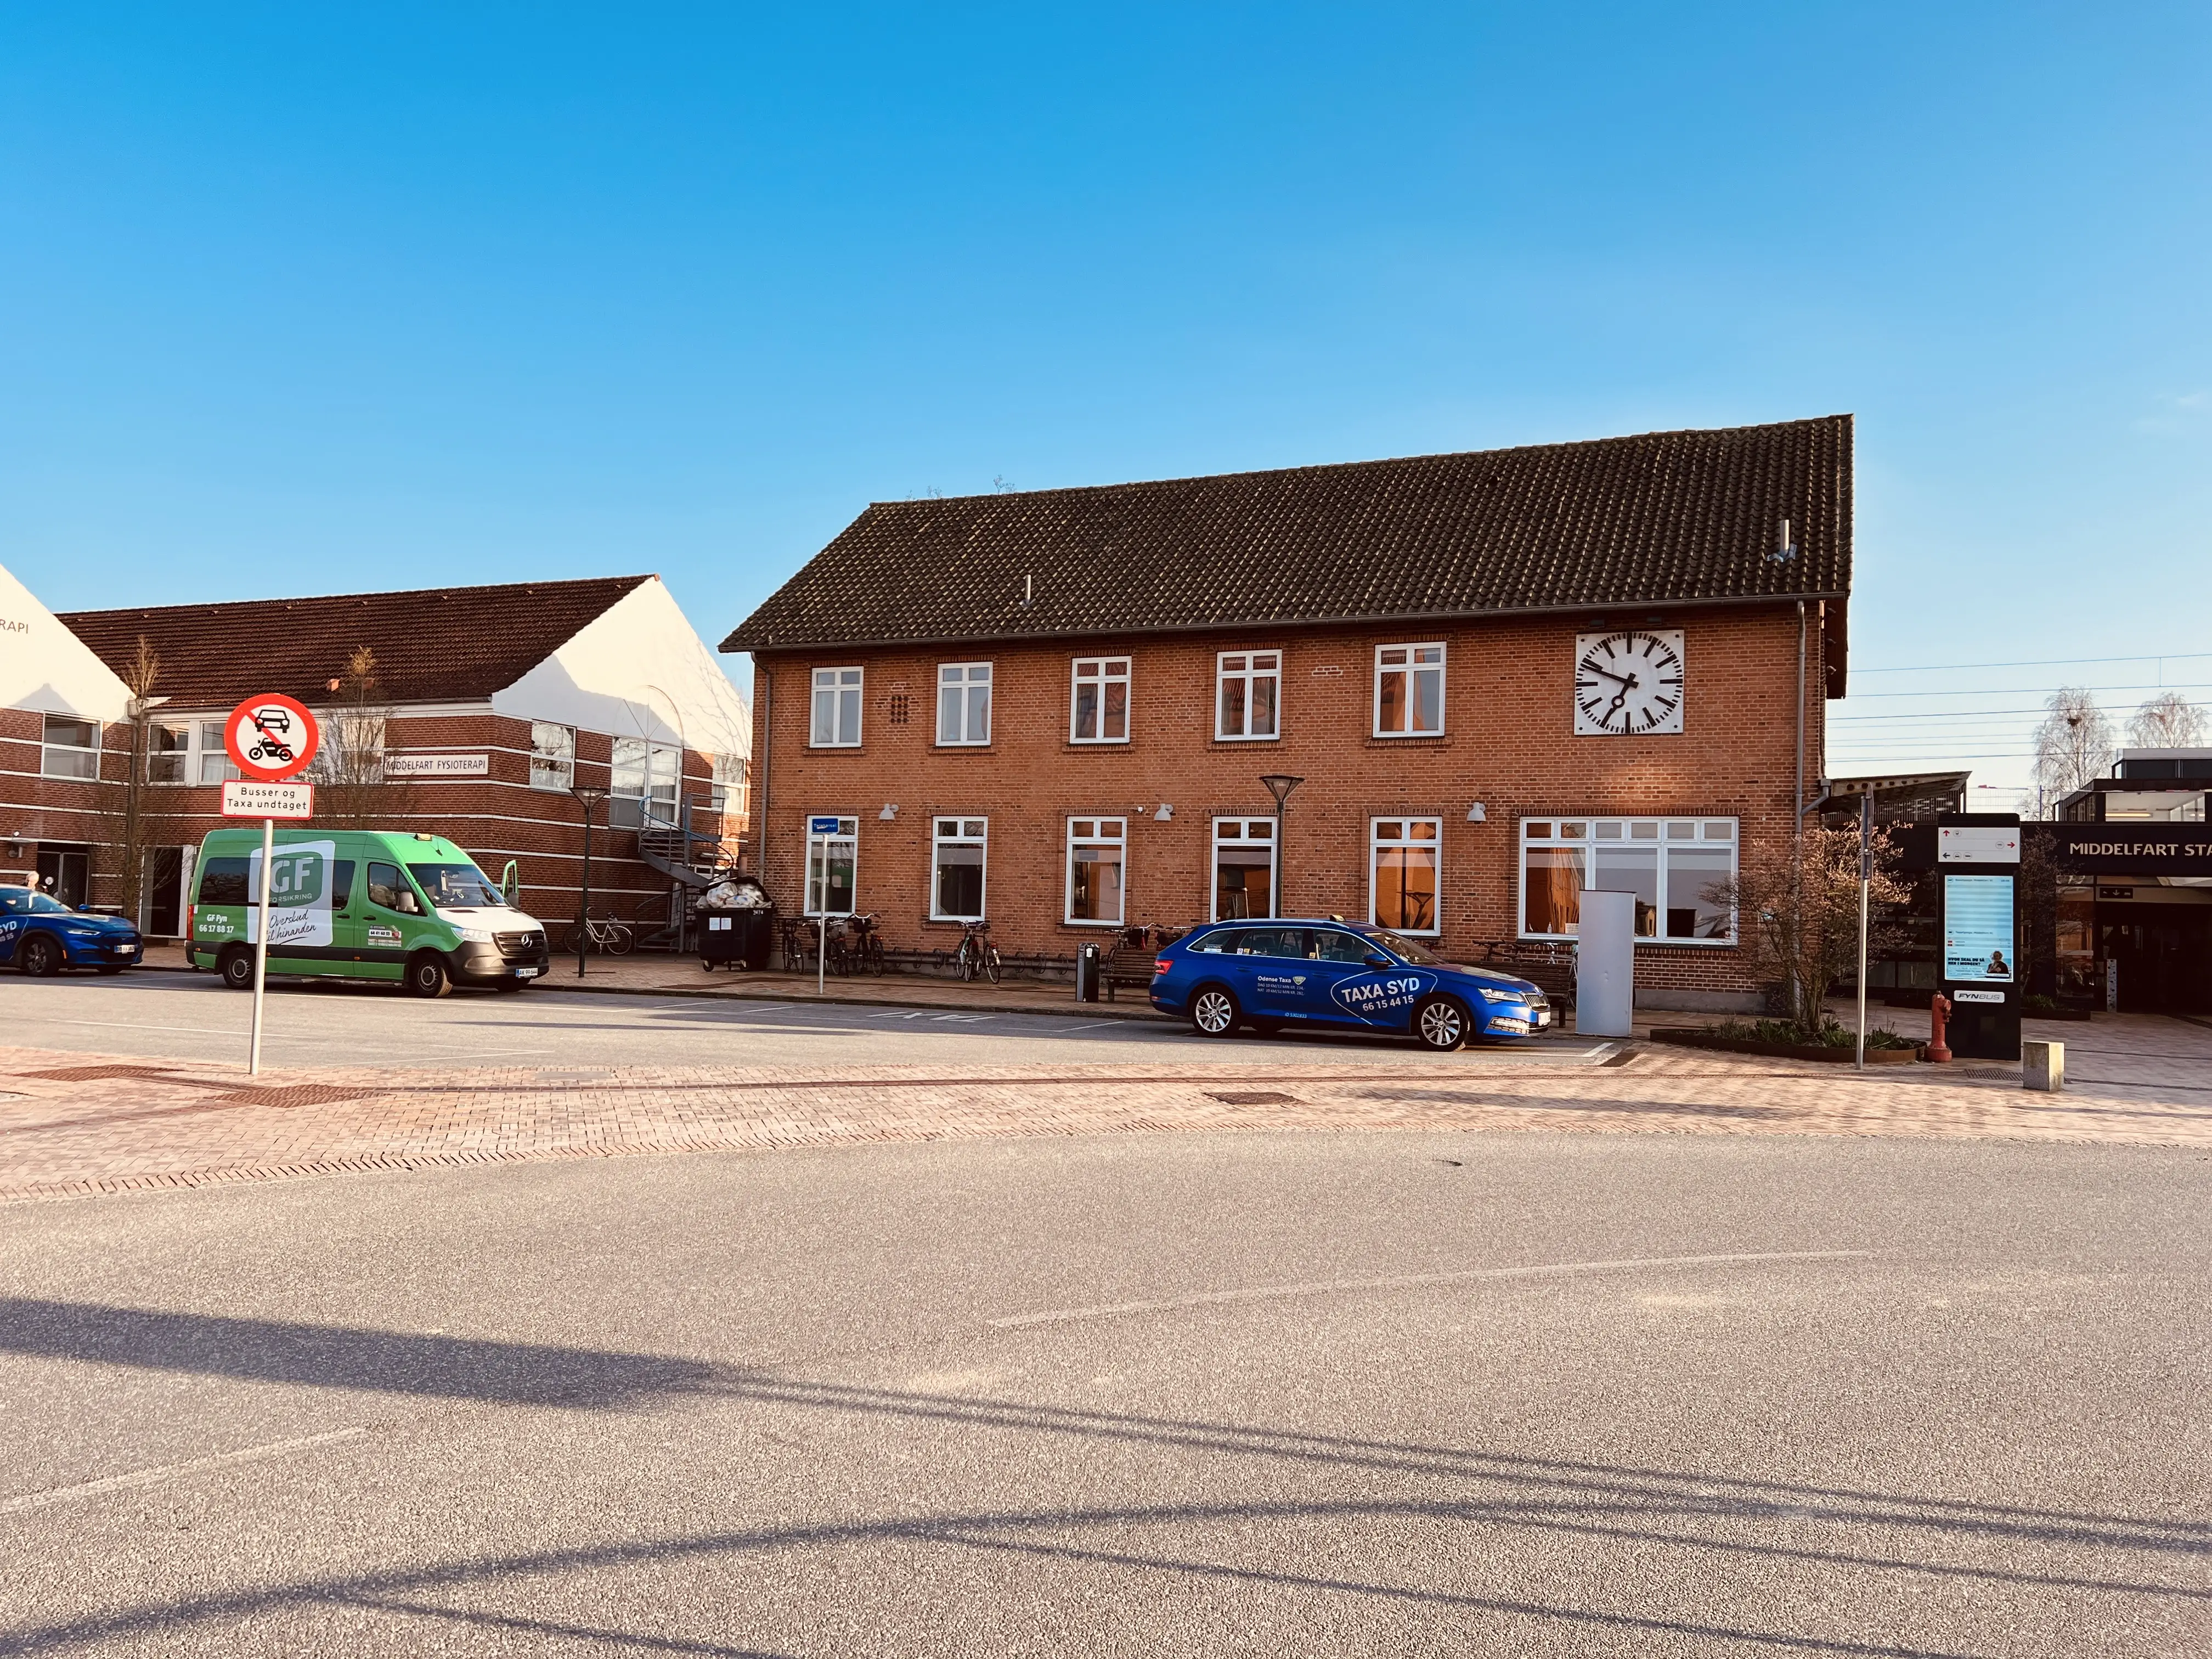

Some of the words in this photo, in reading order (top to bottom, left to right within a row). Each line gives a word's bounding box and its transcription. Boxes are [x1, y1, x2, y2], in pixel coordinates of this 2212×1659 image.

[387, 760, 433, 770] MIDDELFART
[437, 760, 486, 769] FYSIOTERAPI
[241, 787, 279, 797] Busser
[283, 791, 295, 799] og
[227, 798, 252, 808] Taxa
[257, 800, 307, 810] undtaget
[2070, 843, 2179, 856] MIDDELFART
[270, 857, 314, 893] GF
[207, 913, 215, 922] GF
[216, 914, 228, 924] Fyn
[269, 909, 309, 928] Overskud
[208, 924, 216, 933] 17
[276, 921, 317, 939] hinanden
[1341, 984, 1384, 1003] TAXA
[1387, 978, 1420, 995] SYD
[1362, 1003, 1374, 1011] 66
[1376, 1000, 1388, 1009] 15
[1390, 997, 1401, 1007] 44
[1403, 995, 1414, 1004] 15
